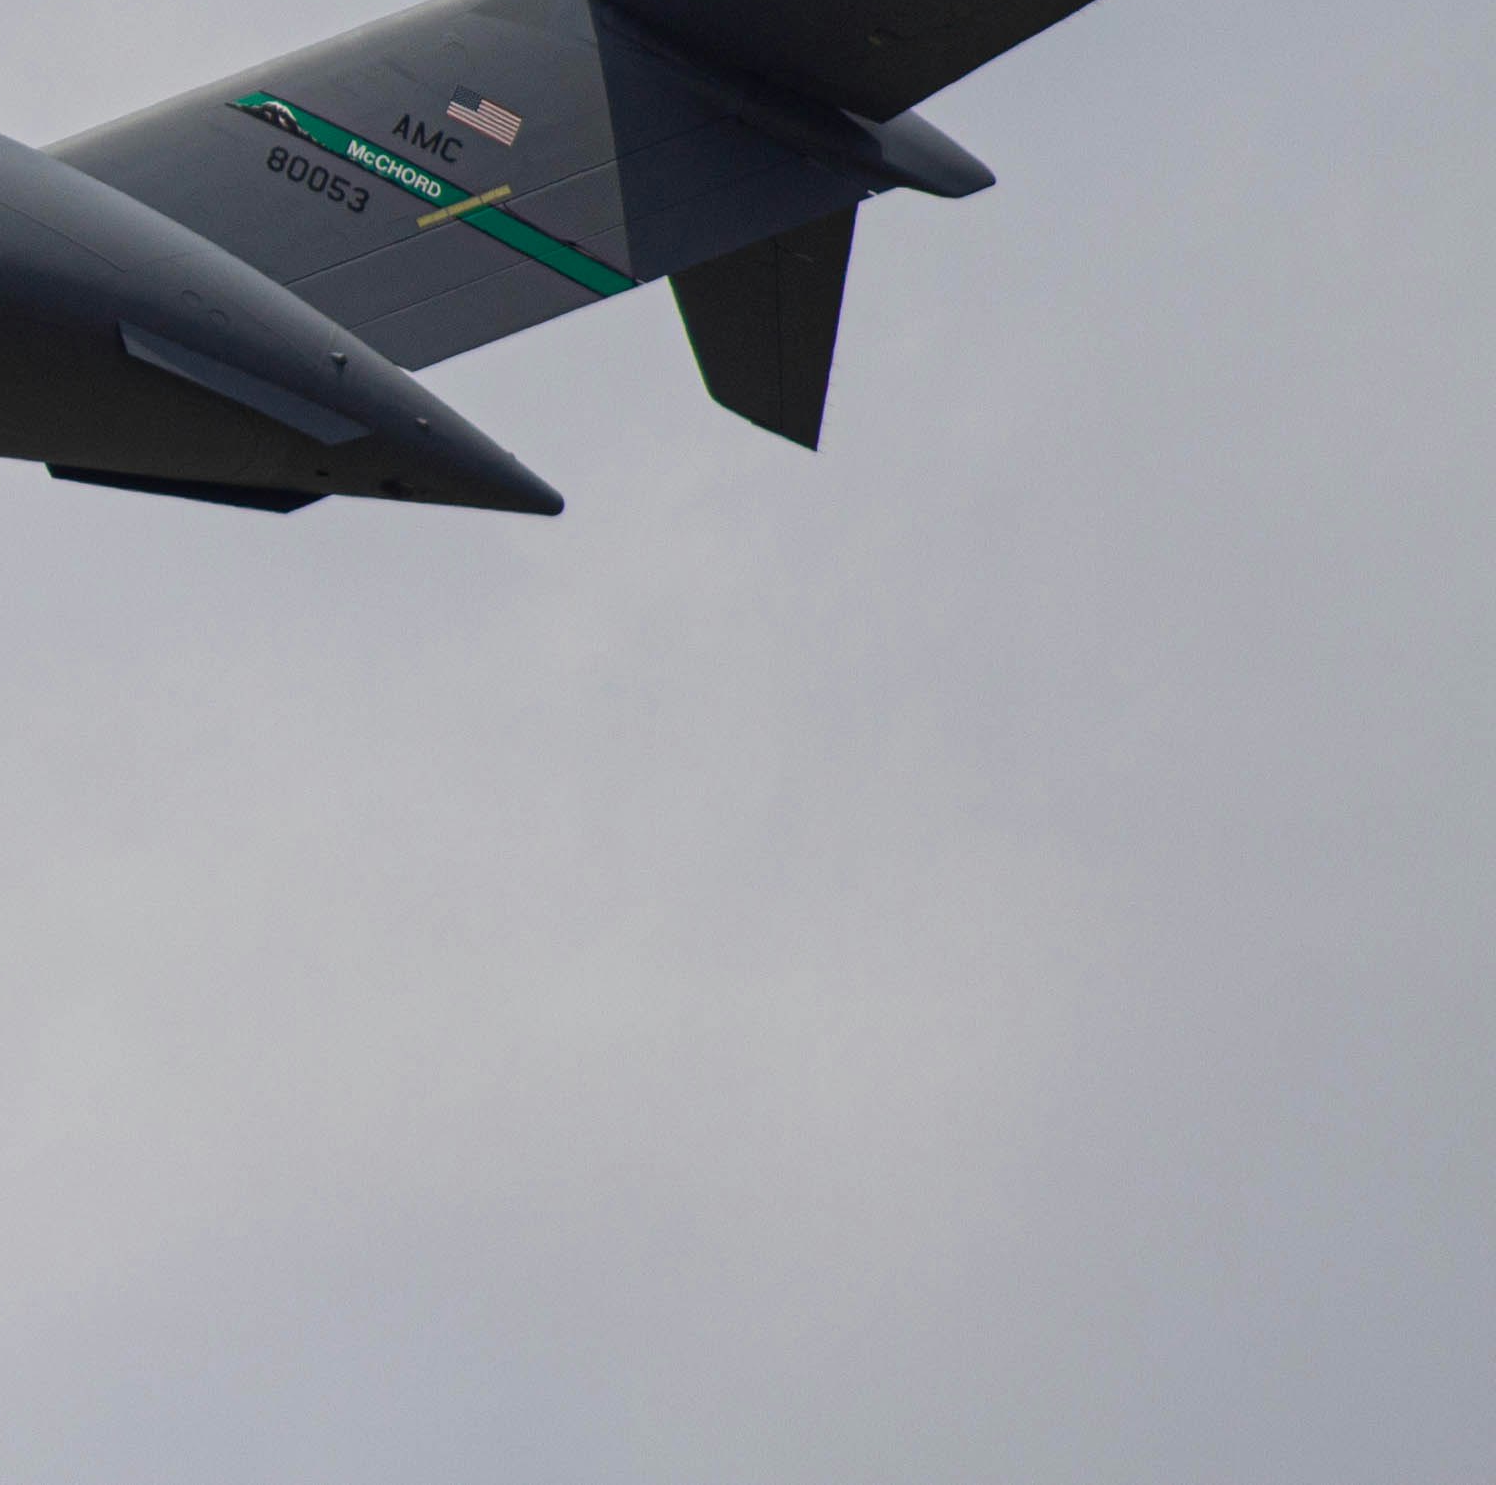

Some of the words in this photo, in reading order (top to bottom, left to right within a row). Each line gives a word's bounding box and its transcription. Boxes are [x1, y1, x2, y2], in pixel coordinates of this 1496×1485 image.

[346, 138, 442, 198] McCHORD
[392, 113, 463, 164] AMC
[266, 145, 370, 214] 80053
